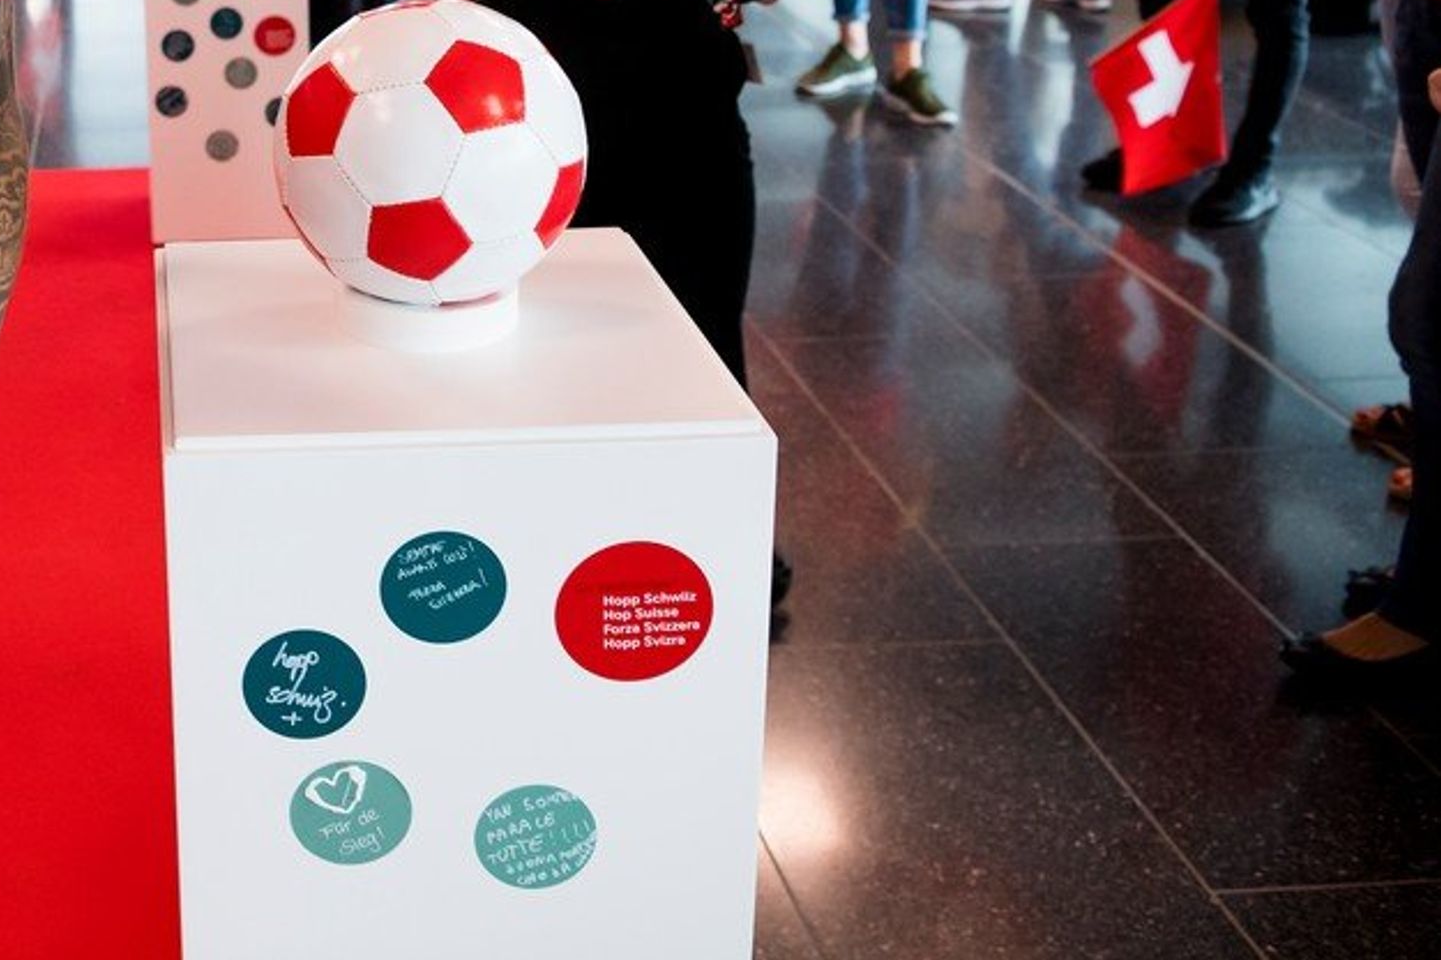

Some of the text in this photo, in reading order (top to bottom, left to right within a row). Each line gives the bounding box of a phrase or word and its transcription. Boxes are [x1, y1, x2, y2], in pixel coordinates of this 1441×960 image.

[602, 595, 640, 608] Hopp
[602, 607, 679, 622] Hop Suisse
[602, 620, 701, 635] Forza Svizzera
[603, 635, 687, 650] Hopp Svizra
